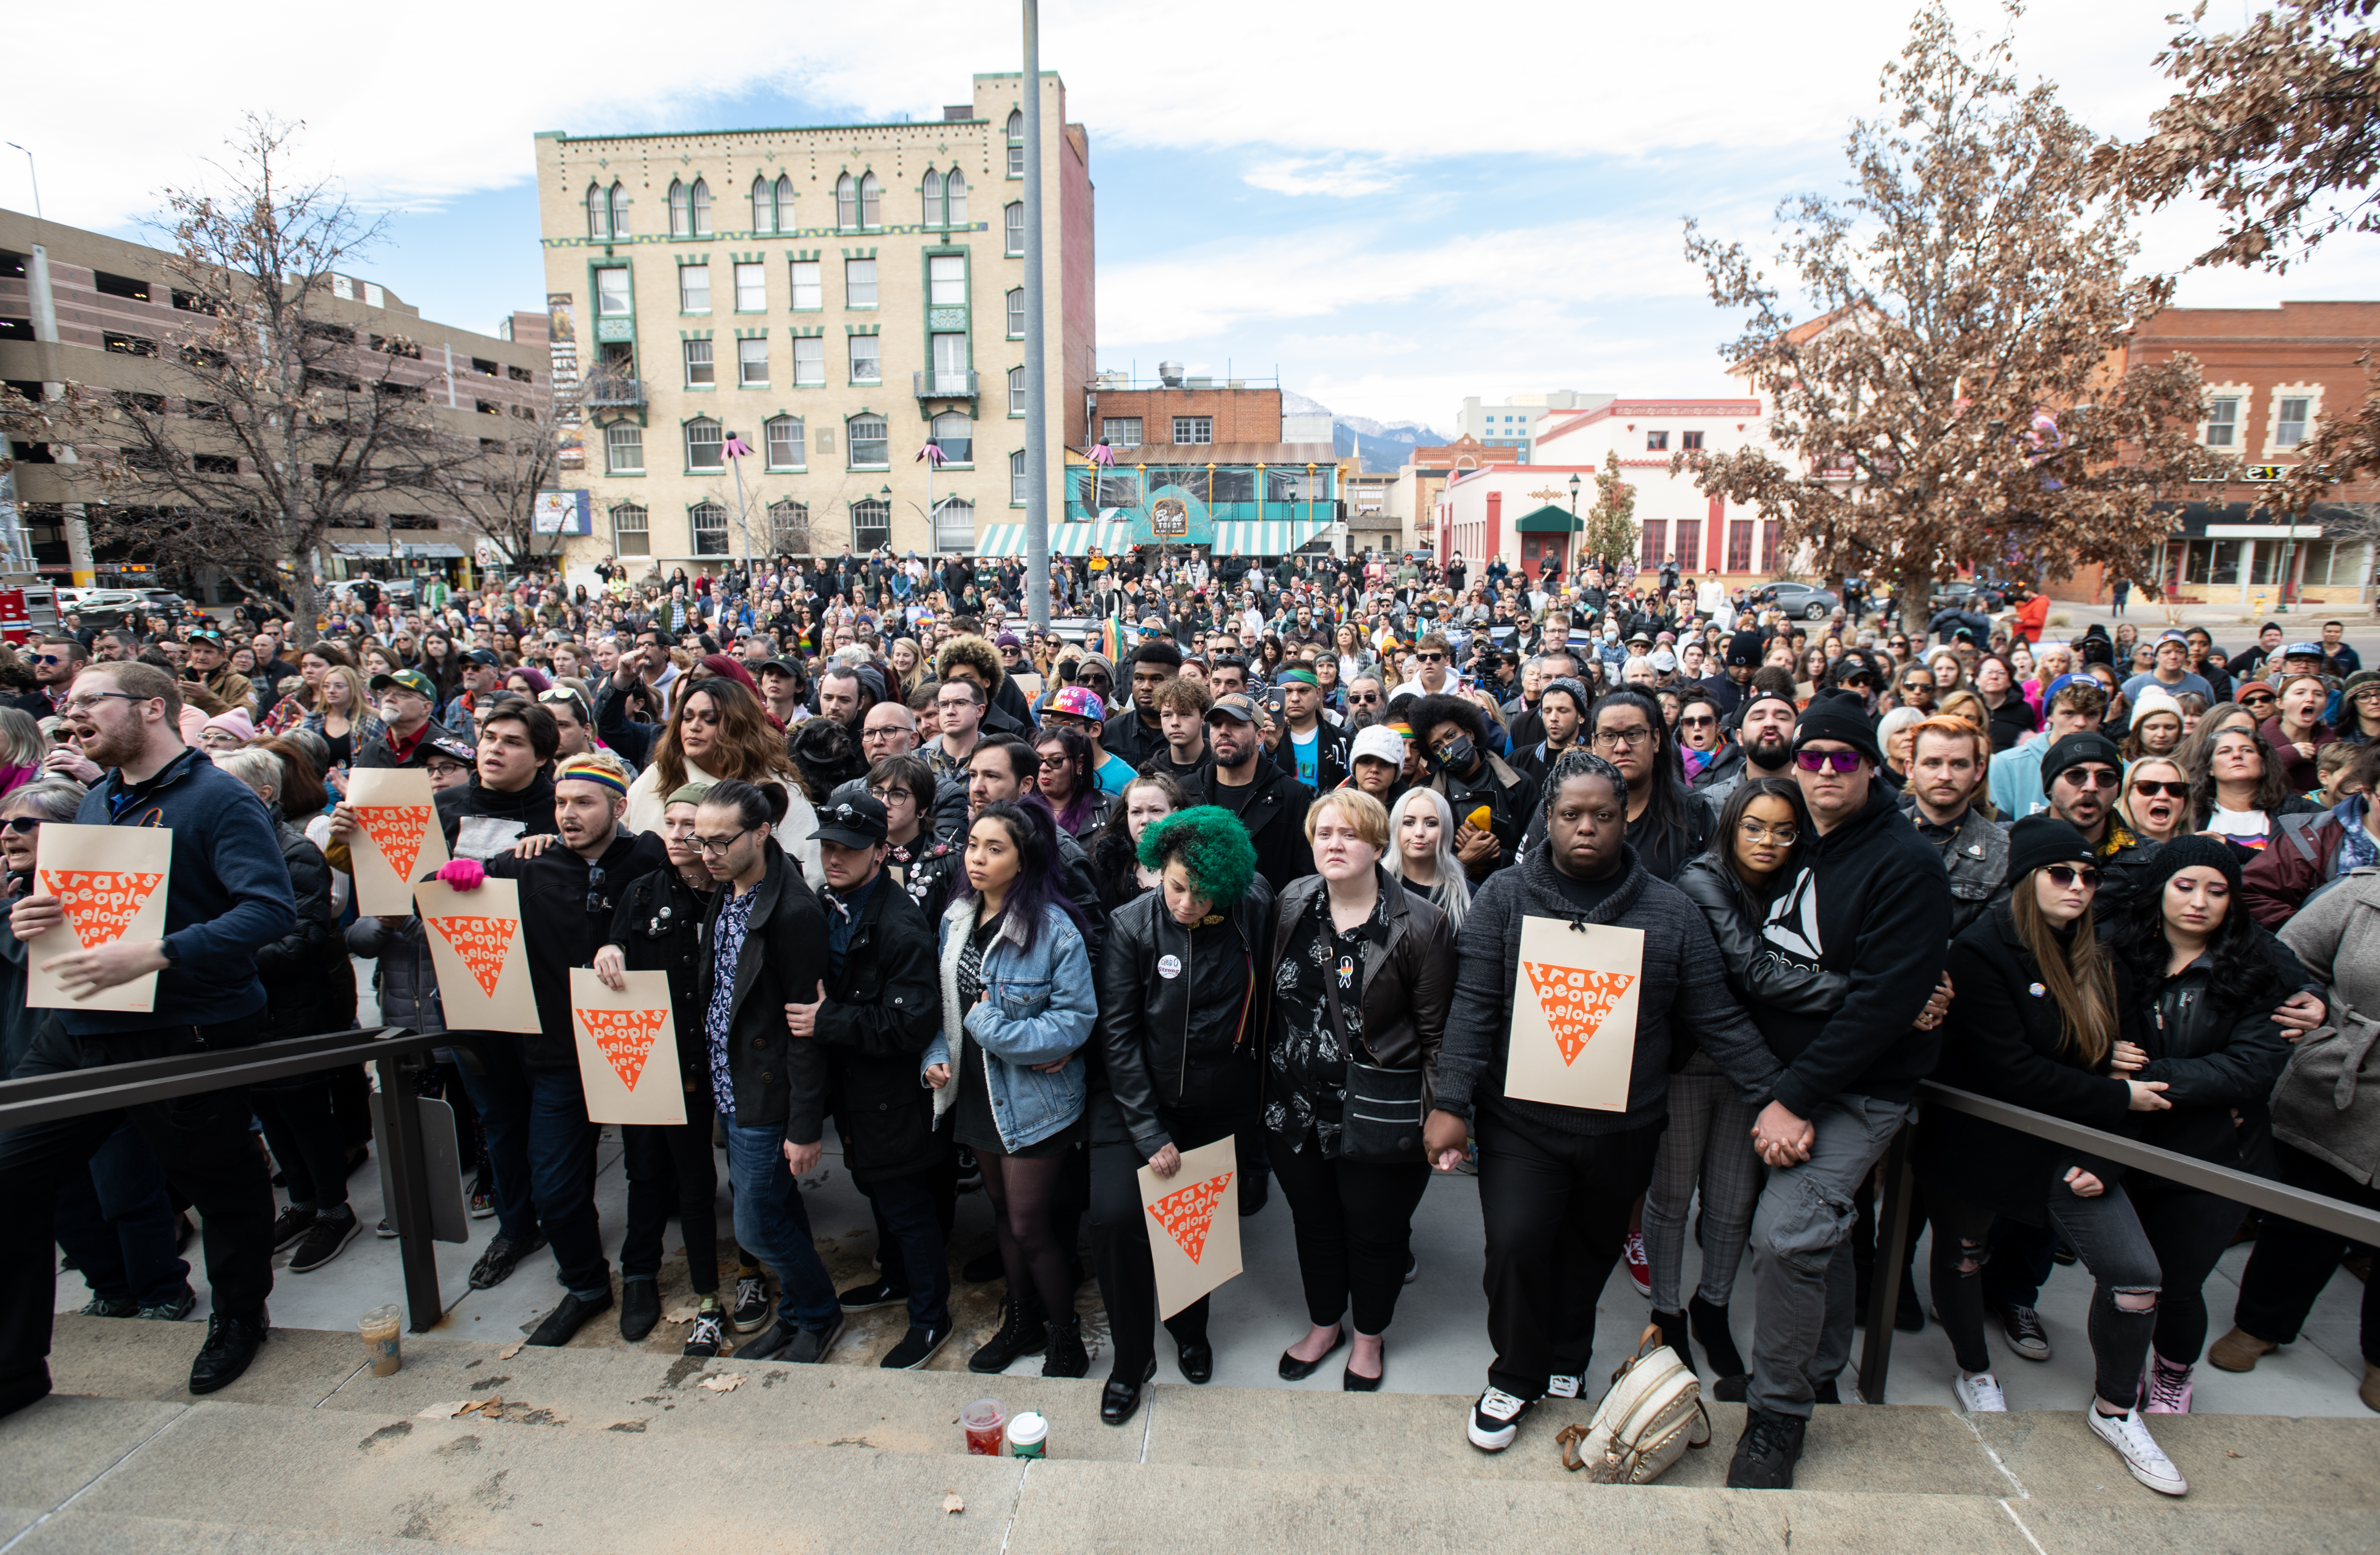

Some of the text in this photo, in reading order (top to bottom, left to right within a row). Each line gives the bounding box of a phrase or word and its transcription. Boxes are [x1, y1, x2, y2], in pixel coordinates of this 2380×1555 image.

[1071, 689, 1080, 697] is
[354, 806, 429, 820] trans
[366, 817, 427, 837] people
[375, 834, 423, 849] belong
[387, 848, 415, 863] here
[47, 872, 158, 889] trans
[60, 888, 147, 912] people
[69, 907, 135, 926] belong
[435, 917, 514, 932] trans
[80, 927, 117, 944] here
[450, 931, 511, 951] people
[459, 947, 506, 963] belong
[471, 963, 498, 978] here
[1158, 967, 1179, 975] Strong
[1530, 963, 1629, 989] trans
[1538, 984, 1619, 1011] people
[581, 1009, 664, 1025] trans
[1545, 1004, 1607, 1025] belong
[593, 1023, 658, 1044] people
[1552, 1024, 1589, 1043] here
[601, 1041, 651, 1057] belong
[612, 1057, 642, 1072] here
[1153, 1175, 1229, 1216] trans
[1164, 1189, 1223, 1229] people
[1171, 1205, 1214, 1240] belong
[1181, 1227, 1207, 1250] here
